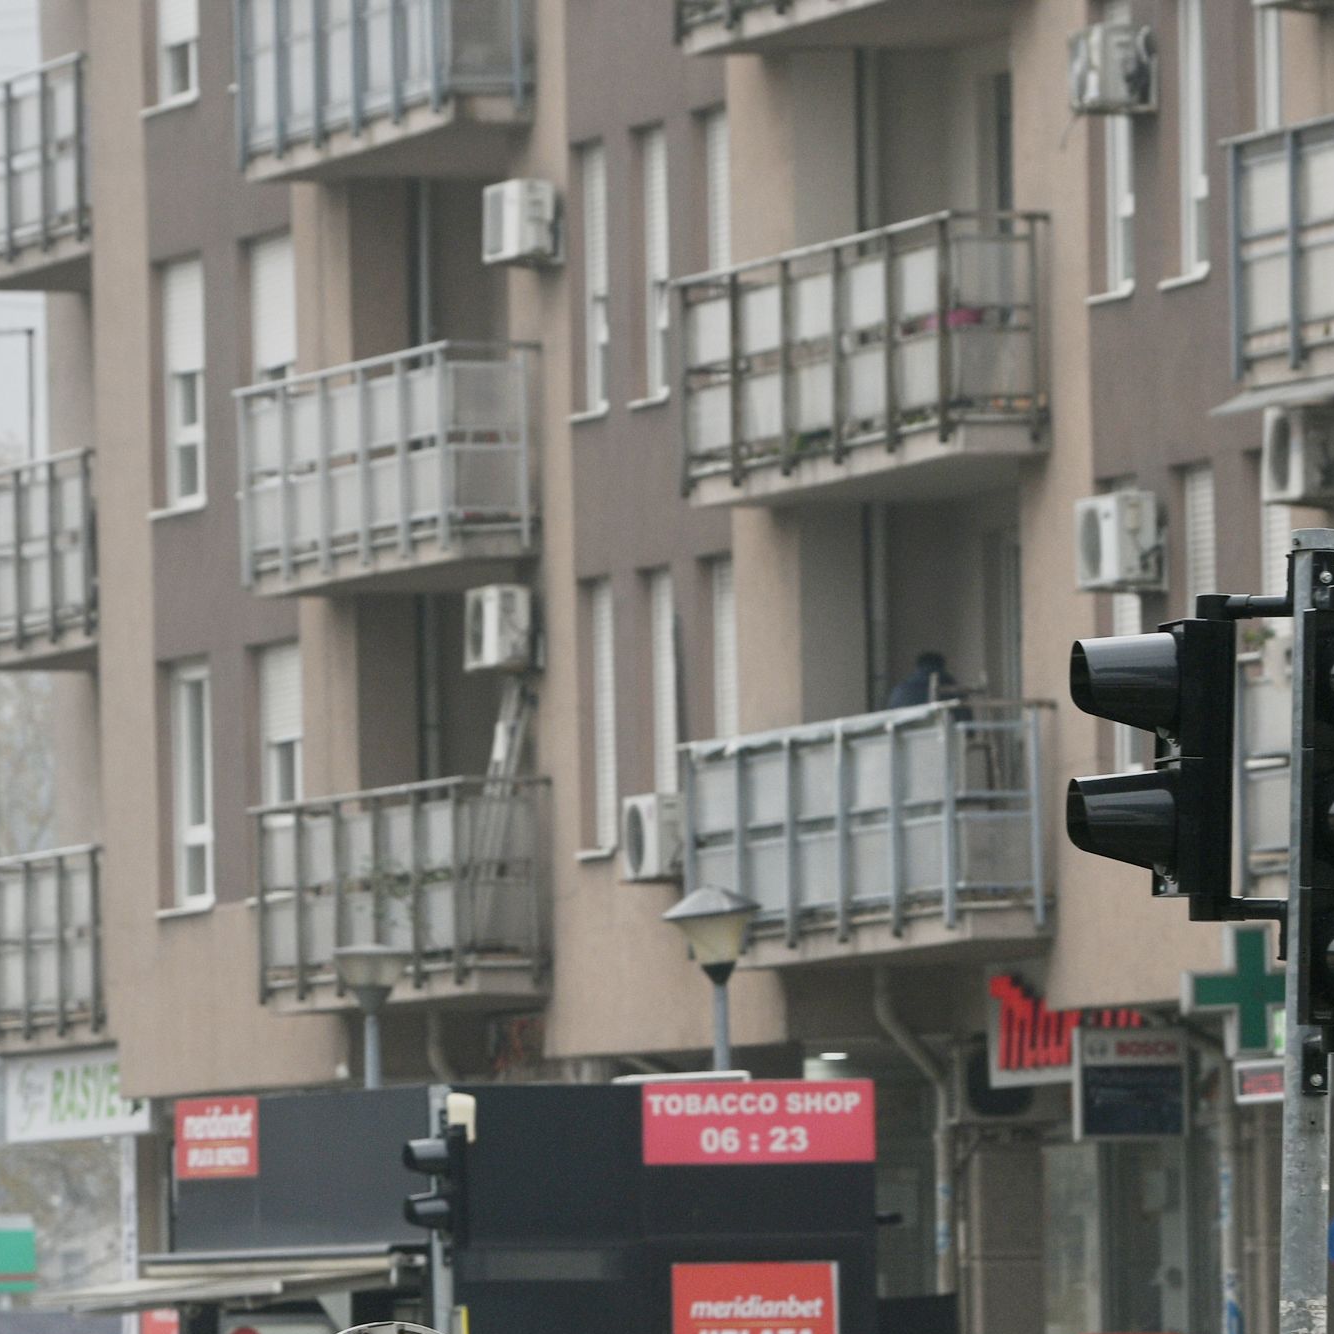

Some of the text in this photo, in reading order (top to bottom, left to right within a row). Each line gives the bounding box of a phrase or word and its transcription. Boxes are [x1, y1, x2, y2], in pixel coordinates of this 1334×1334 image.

[1116, 1040, 1178, 1057] BOSCH
[50, 1063, 141, 1122] RASVE
[648, 1091, 861, 1116] TOBACCO SHOP
[700, 1126, 740, 1153] 06
[769, 1125, 809, 1153] 23
[689, 1294, 824, 1320] meridianbet
